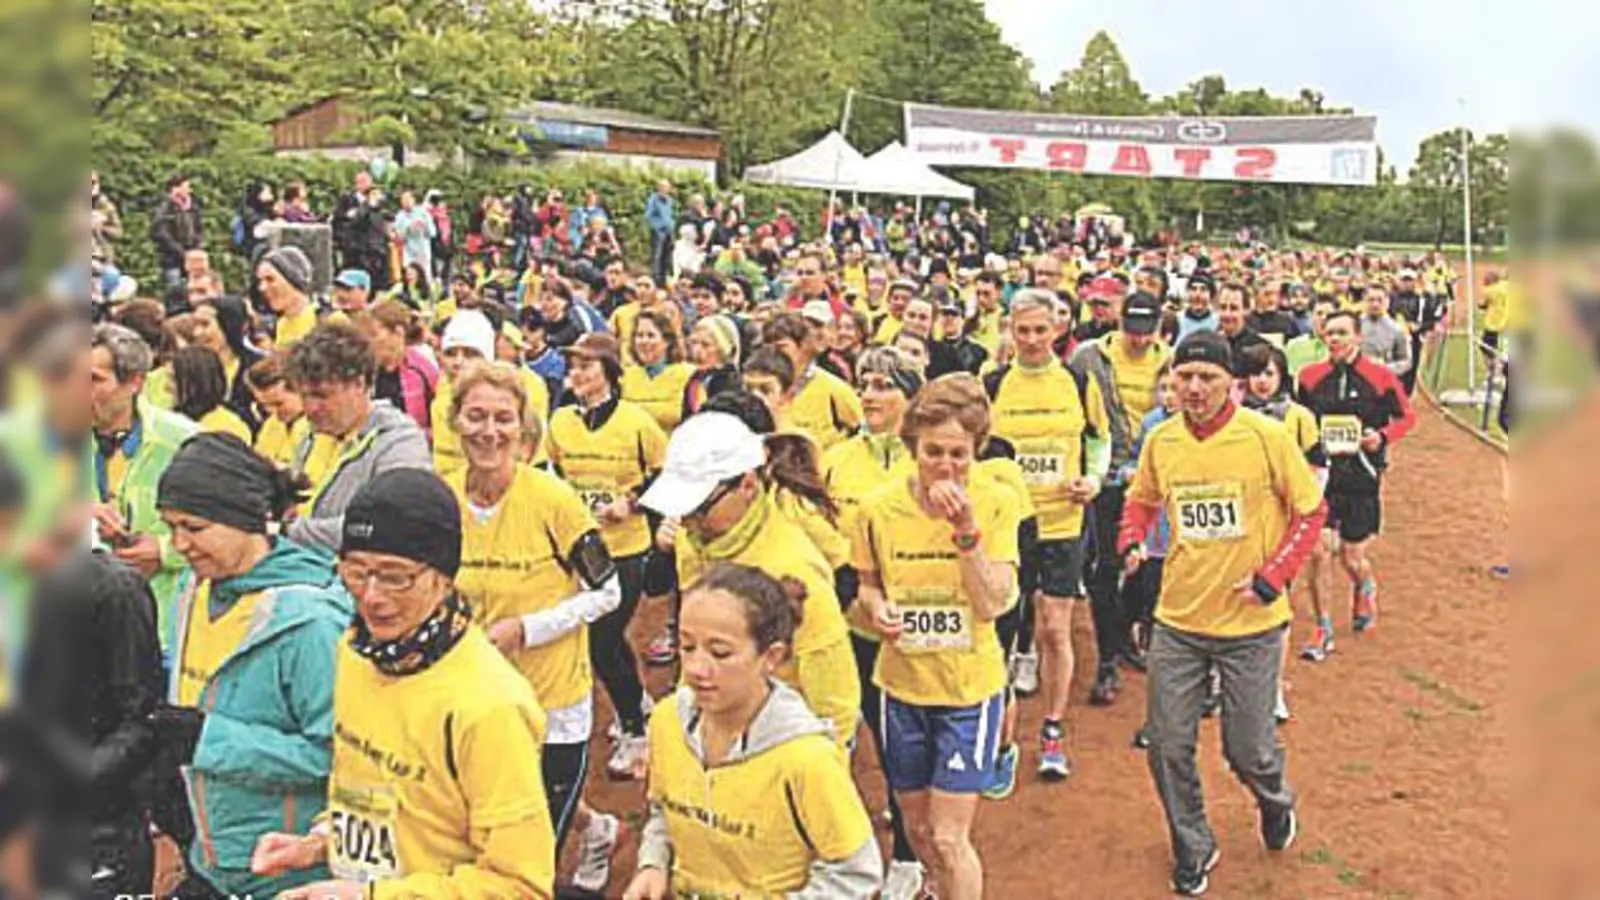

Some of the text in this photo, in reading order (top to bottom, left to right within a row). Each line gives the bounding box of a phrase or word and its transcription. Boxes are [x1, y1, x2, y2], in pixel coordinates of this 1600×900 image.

[1181, 501, 1236, 529] 5031
[902, 611, 962, 634] 5083
[331, 810, 397, 870] 5024
